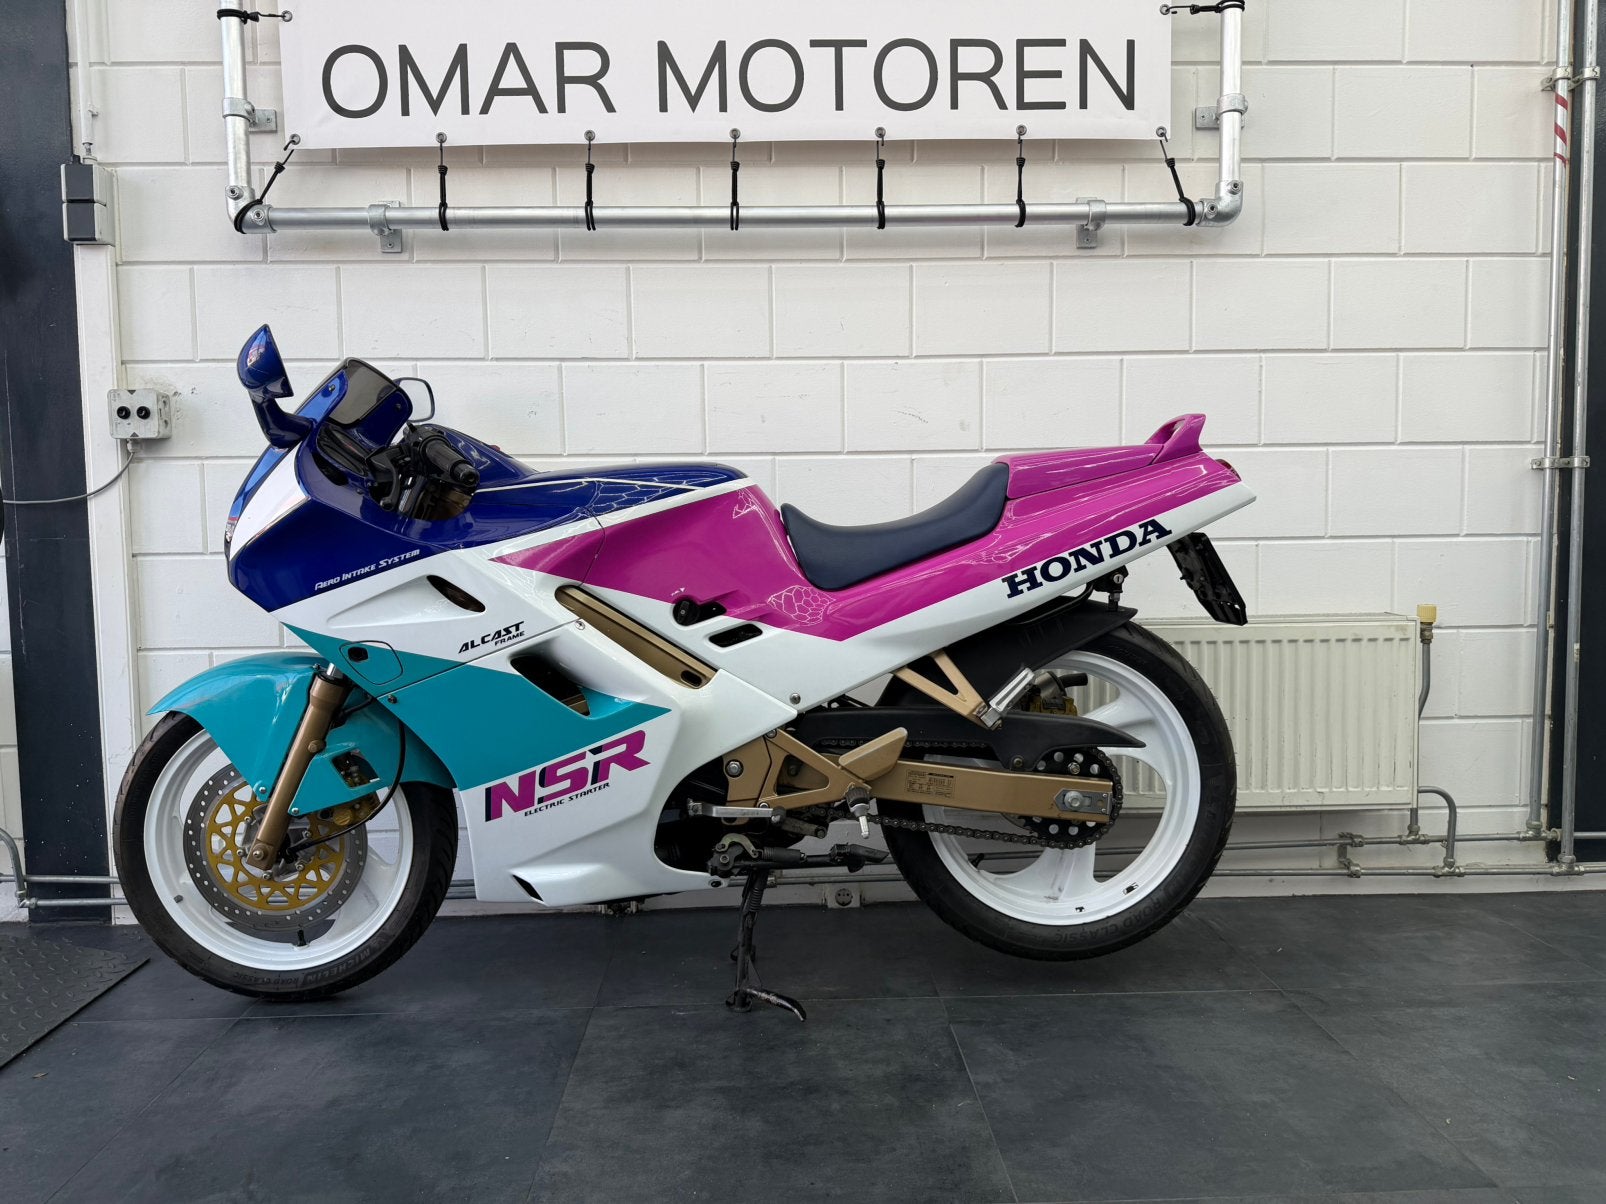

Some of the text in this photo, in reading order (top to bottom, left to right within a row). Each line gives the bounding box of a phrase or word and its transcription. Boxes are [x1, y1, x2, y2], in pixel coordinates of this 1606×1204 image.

[322, 37, 1136, 119] OMAR MOTOREN
[1001, 518, 1173, 599] HONDA
[458, 620, 525, 654] ALCAST
[494, 630, 525, 646] FRAME
[485, 729, 651, 822] NSR
[524, 782, 610, 817] ELECTRIC STARTER
